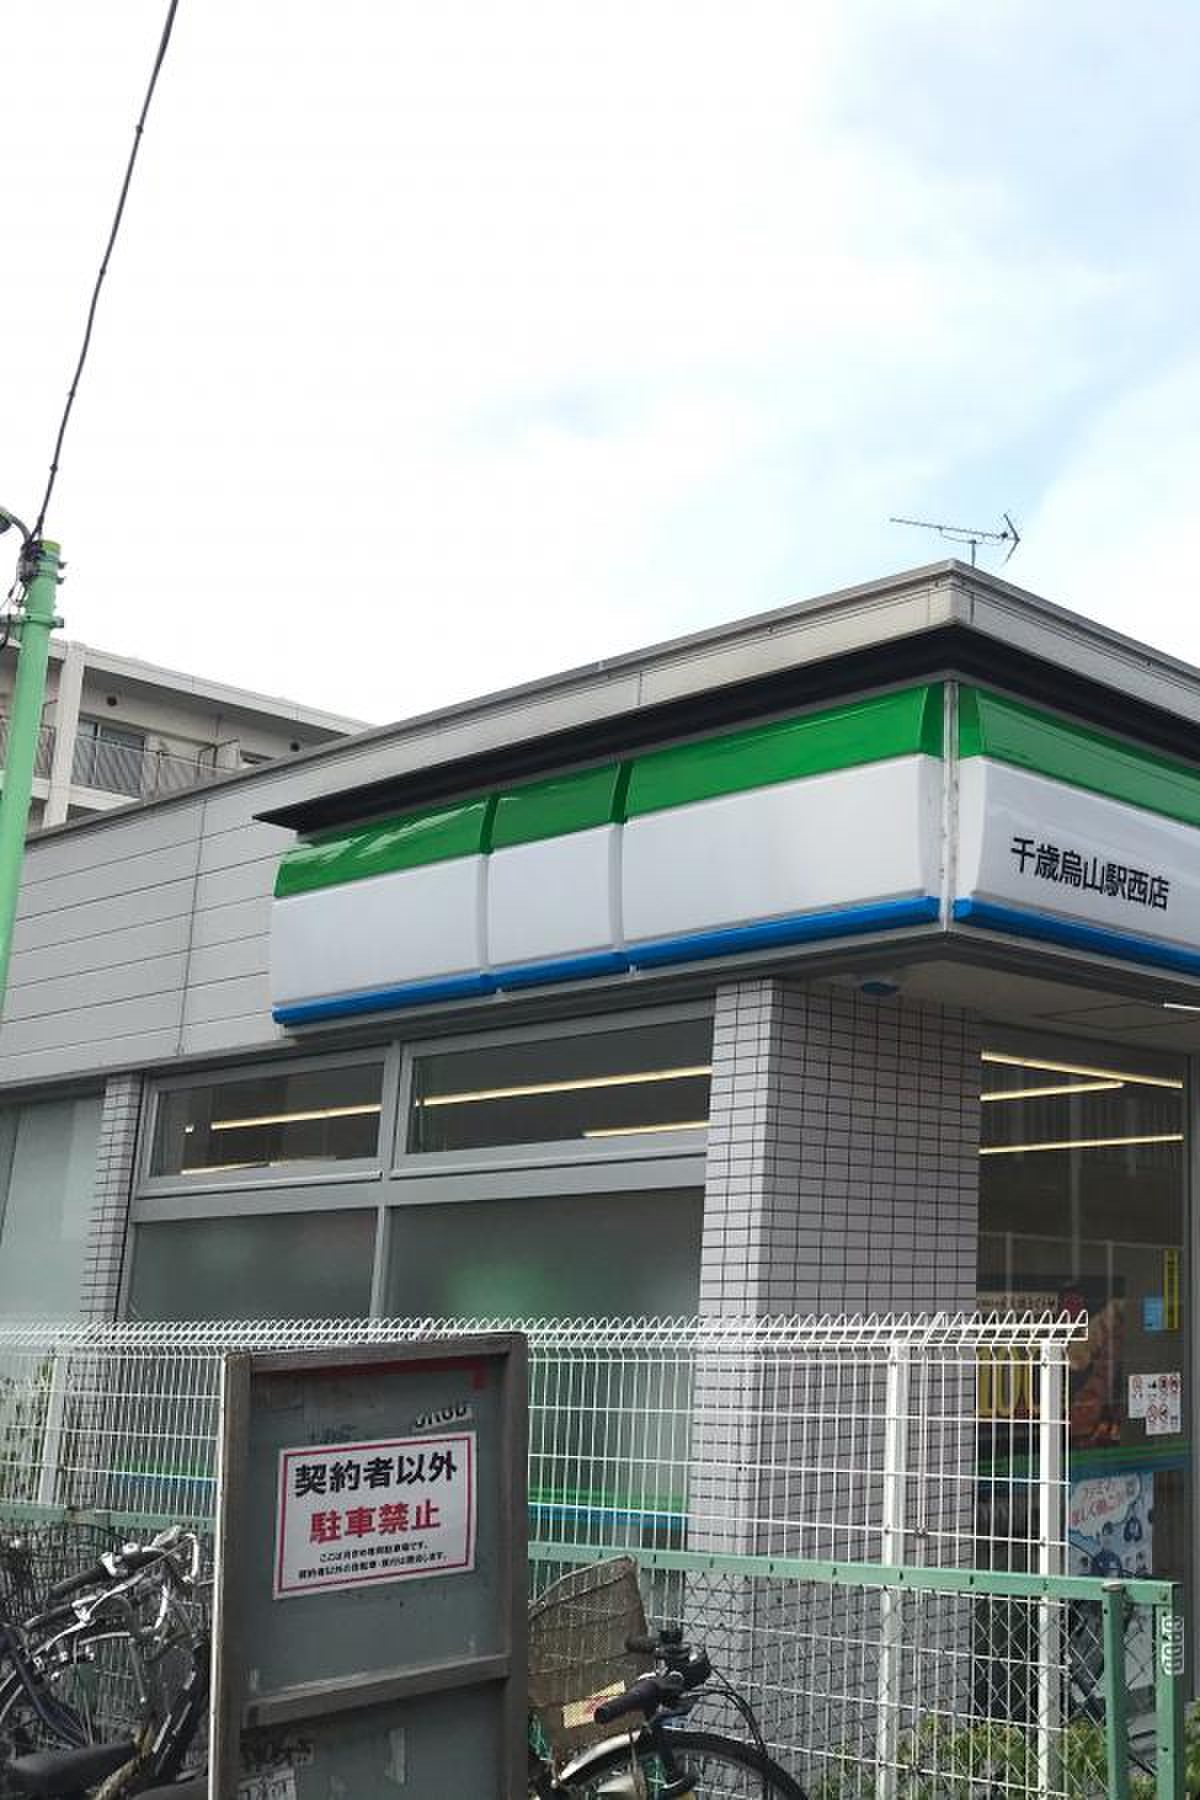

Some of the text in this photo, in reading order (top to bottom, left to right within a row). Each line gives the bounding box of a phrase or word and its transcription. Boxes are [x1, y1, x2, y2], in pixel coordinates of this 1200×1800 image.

[1010, 836, 1170, 911] 千歳烏山駅西店
[295, 1449, 458, 1498] 契約者以外
[310, 1498, 441, 1545] 駐車禁止
